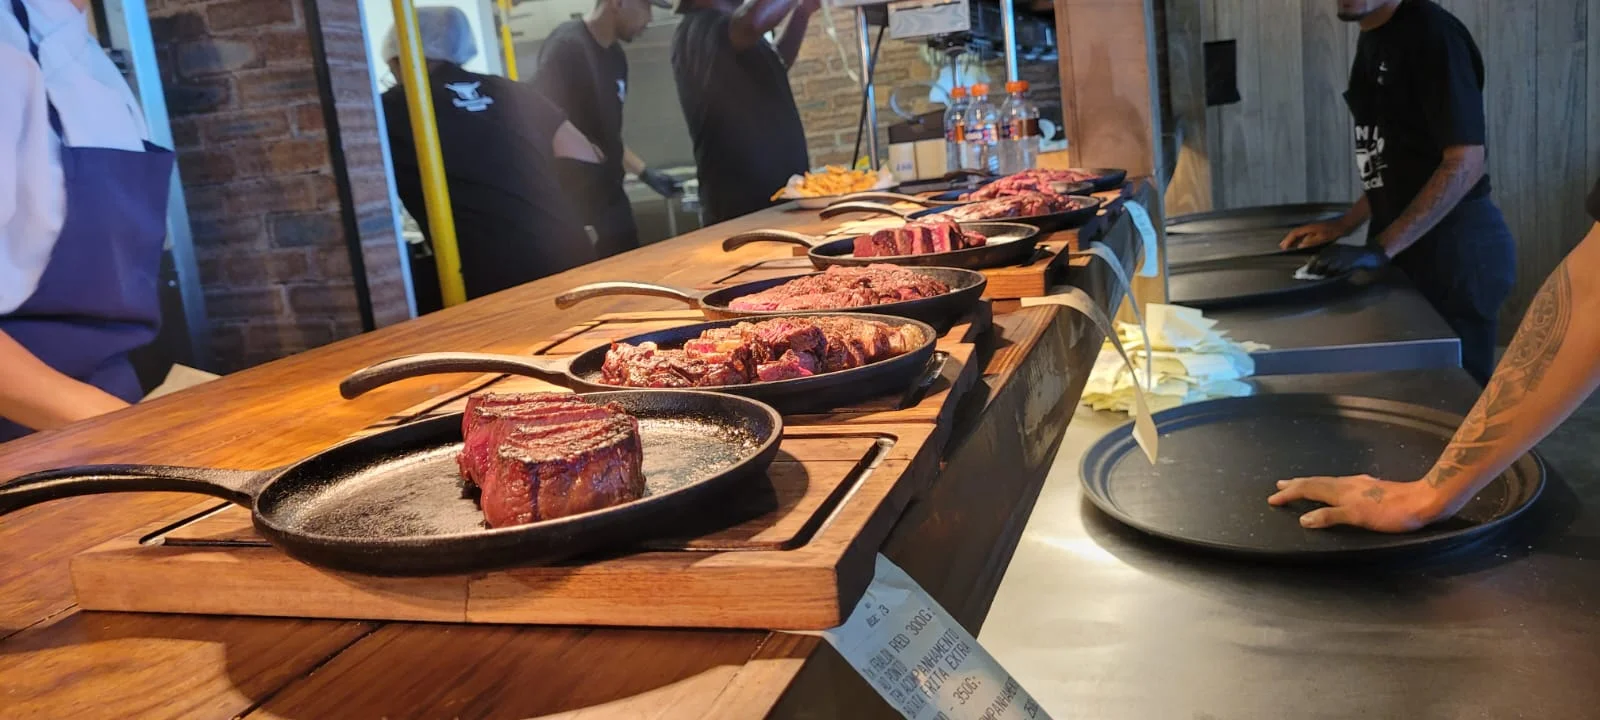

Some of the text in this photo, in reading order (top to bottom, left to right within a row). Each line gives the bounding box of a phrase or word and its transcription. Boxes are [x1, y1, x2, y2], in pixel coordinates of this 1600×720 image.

[888, 633, 911, 653] RED
[905, 607, 936, 636] 300G:
[900, 627, 960, 693] ACOMPANHAMENTO
[919, 666, 950, 699] FRITA
[944, 639, 973, 671] EXTRA
[952, 675, 981, 705] 350G:
